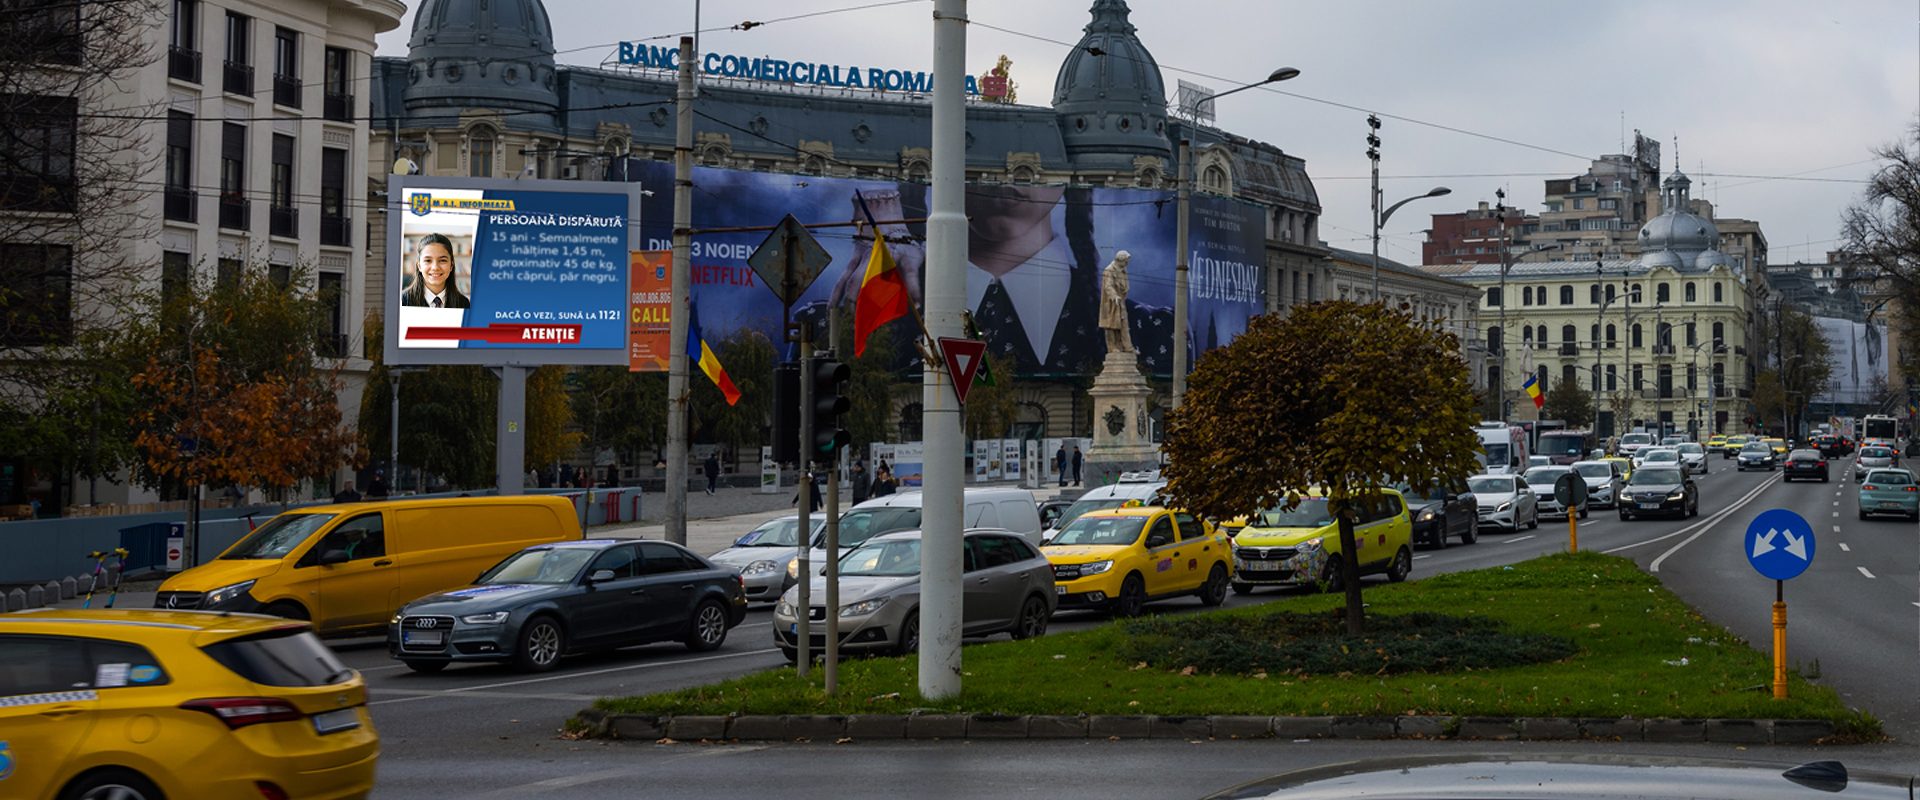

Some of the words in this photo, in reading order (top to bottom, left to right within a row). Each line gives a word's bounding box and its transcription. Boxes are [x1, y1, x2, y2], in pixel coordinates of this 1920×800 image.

[619, 41, 680, 70] BANC
[703, 52, 863, 88] COMERCIALA
[868, 68, 980, 100] ROMA
[490, 213, 556, 226] PERSOANĂ
[559, 215, 622, 228] DISPĂRUTĂ
[492, 231, 506, 242] 15
[510, 232, 528, 242] ani
[539, 233, 618, 244] Semnalmente
[563, 246, 587, 257] 1,45
[590, 248, 605, 257] m,
[705, 242, 759, 259] NOIEM
[491, 258, 560, 270] aproximativ
[563, 259, 578, 269] 45
[581, 259, 595, 269] de
[599, 260, 617, 271] kg,
[488, 271, 513, 280] ochi
[516, 272, 556, 283] căprui,
[560, 272, 579, 284] păr
[582, 274, 619, 285] negru.
[691, 264, 754, 287] NETFLIX
[495, 310, 521, 320] DACĂ
[523, 312, 531, 320] O
[533, 312, 556, 321] VEZI,
[558, 311, 583, 320] SUNĂ
[599, 310, 620, 320] 112!
[631, 307, 671, 323] CALL
[522, 328, 575, 344] ATENȚIE
[172, 526, 179, 535] P
